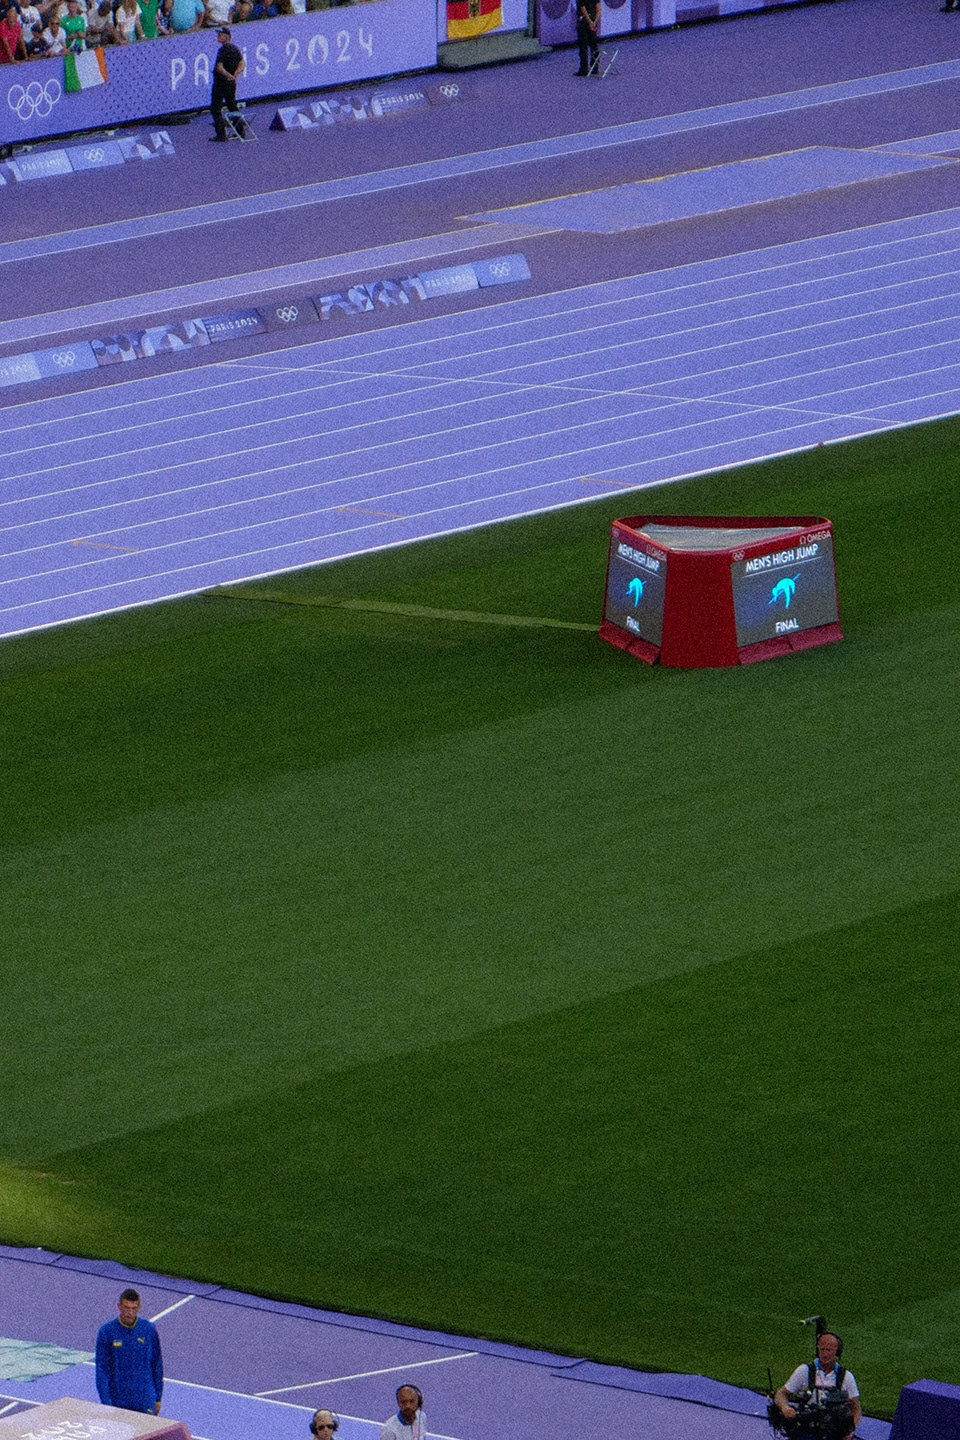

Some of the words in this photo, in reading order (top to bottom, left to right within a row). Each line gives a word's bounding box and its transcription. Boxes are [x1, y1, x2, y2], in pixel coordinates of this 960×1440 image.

[171, 42, 270, 91] PAIS
[285, 28, 373, 70] 2024
[806, 530, 832, 543] OMEGA
[746, 556, 772, 573] MEN'S
[772, 549, 794, 565] HIGH
[796, 544, 819, 560] JUMP
[776, 618, 800, 632] FINAL
